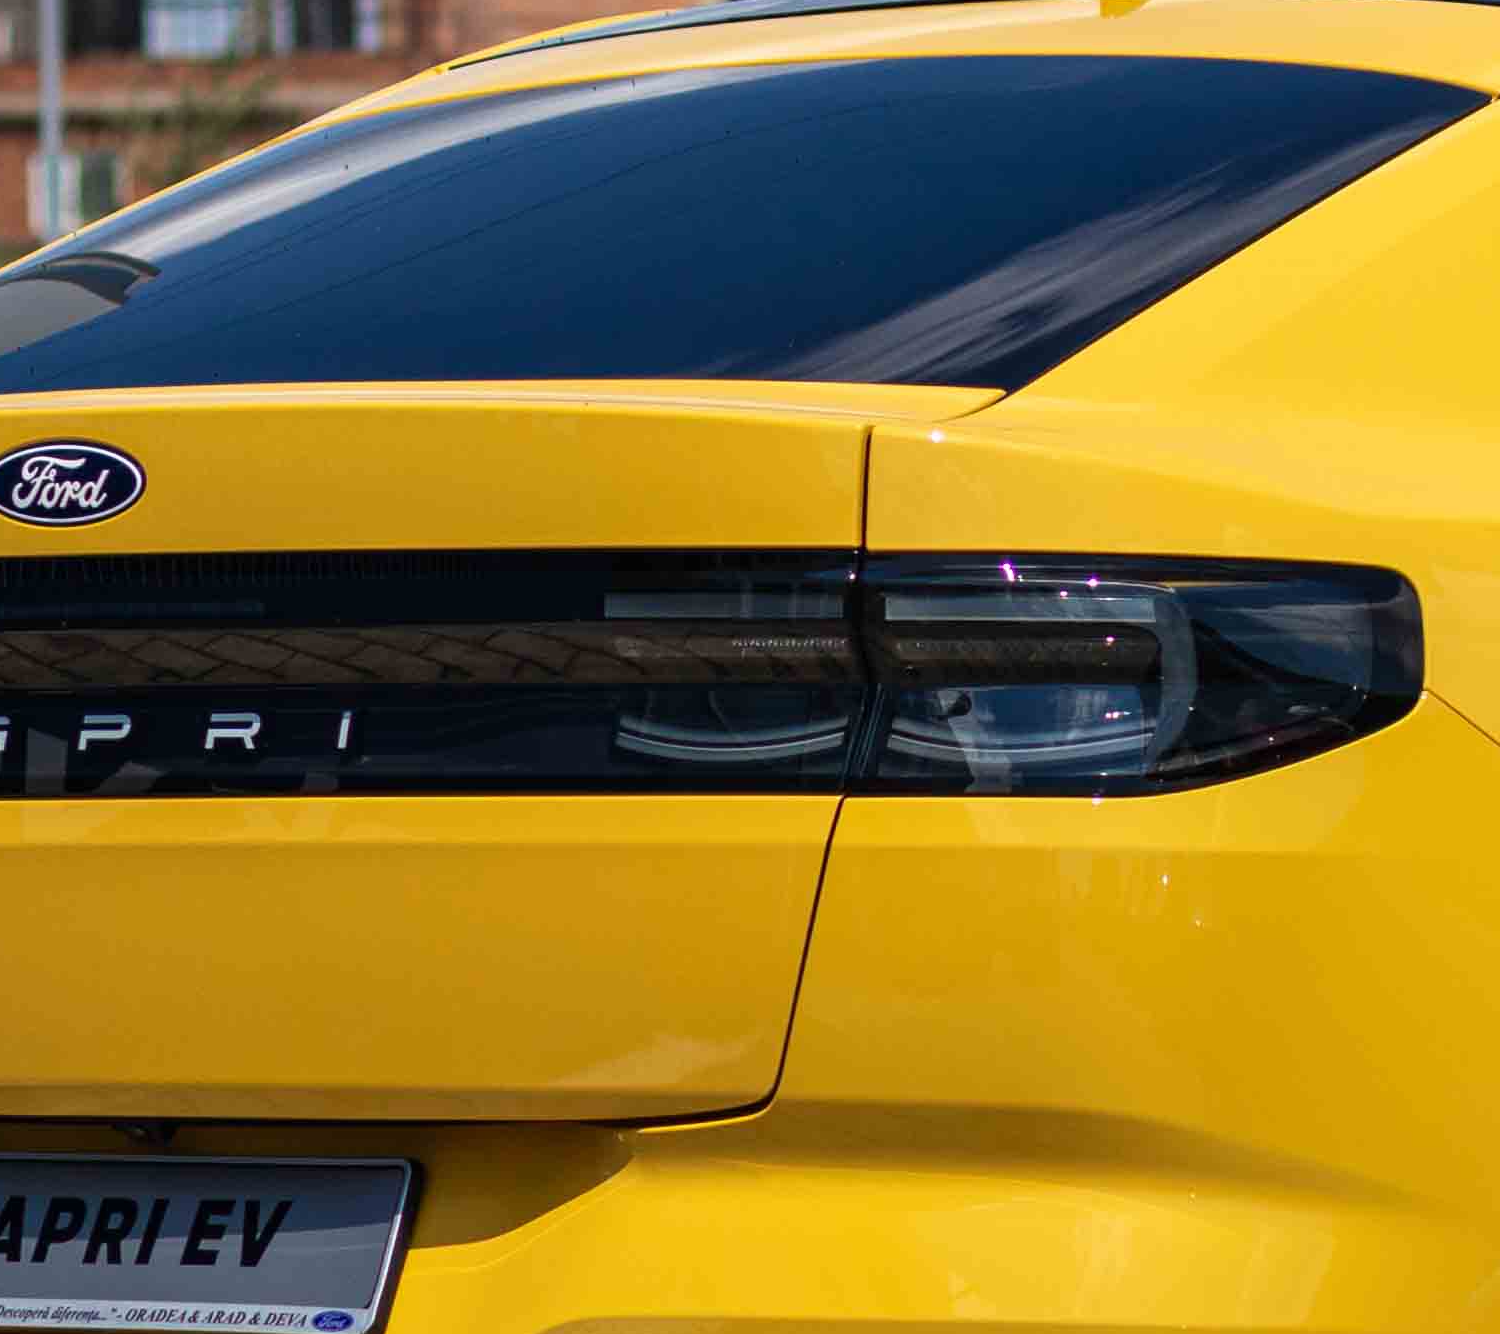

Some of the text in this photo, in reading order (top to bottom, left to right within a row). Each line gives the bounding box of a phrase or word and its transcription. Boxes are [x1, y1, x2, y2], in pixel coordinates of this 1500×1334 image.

[11, 455, 110, 509] Ford
[180, 1198, 294, 1268] EV
[125, 1308, 187, 1324] ORADEA
[188, 1310, 200, 1324] &
[202, 1310, 246, 1326] ARAD
[249, 1311, 262, 1326] &
[264, 1311, 308, 1328] DEVA
